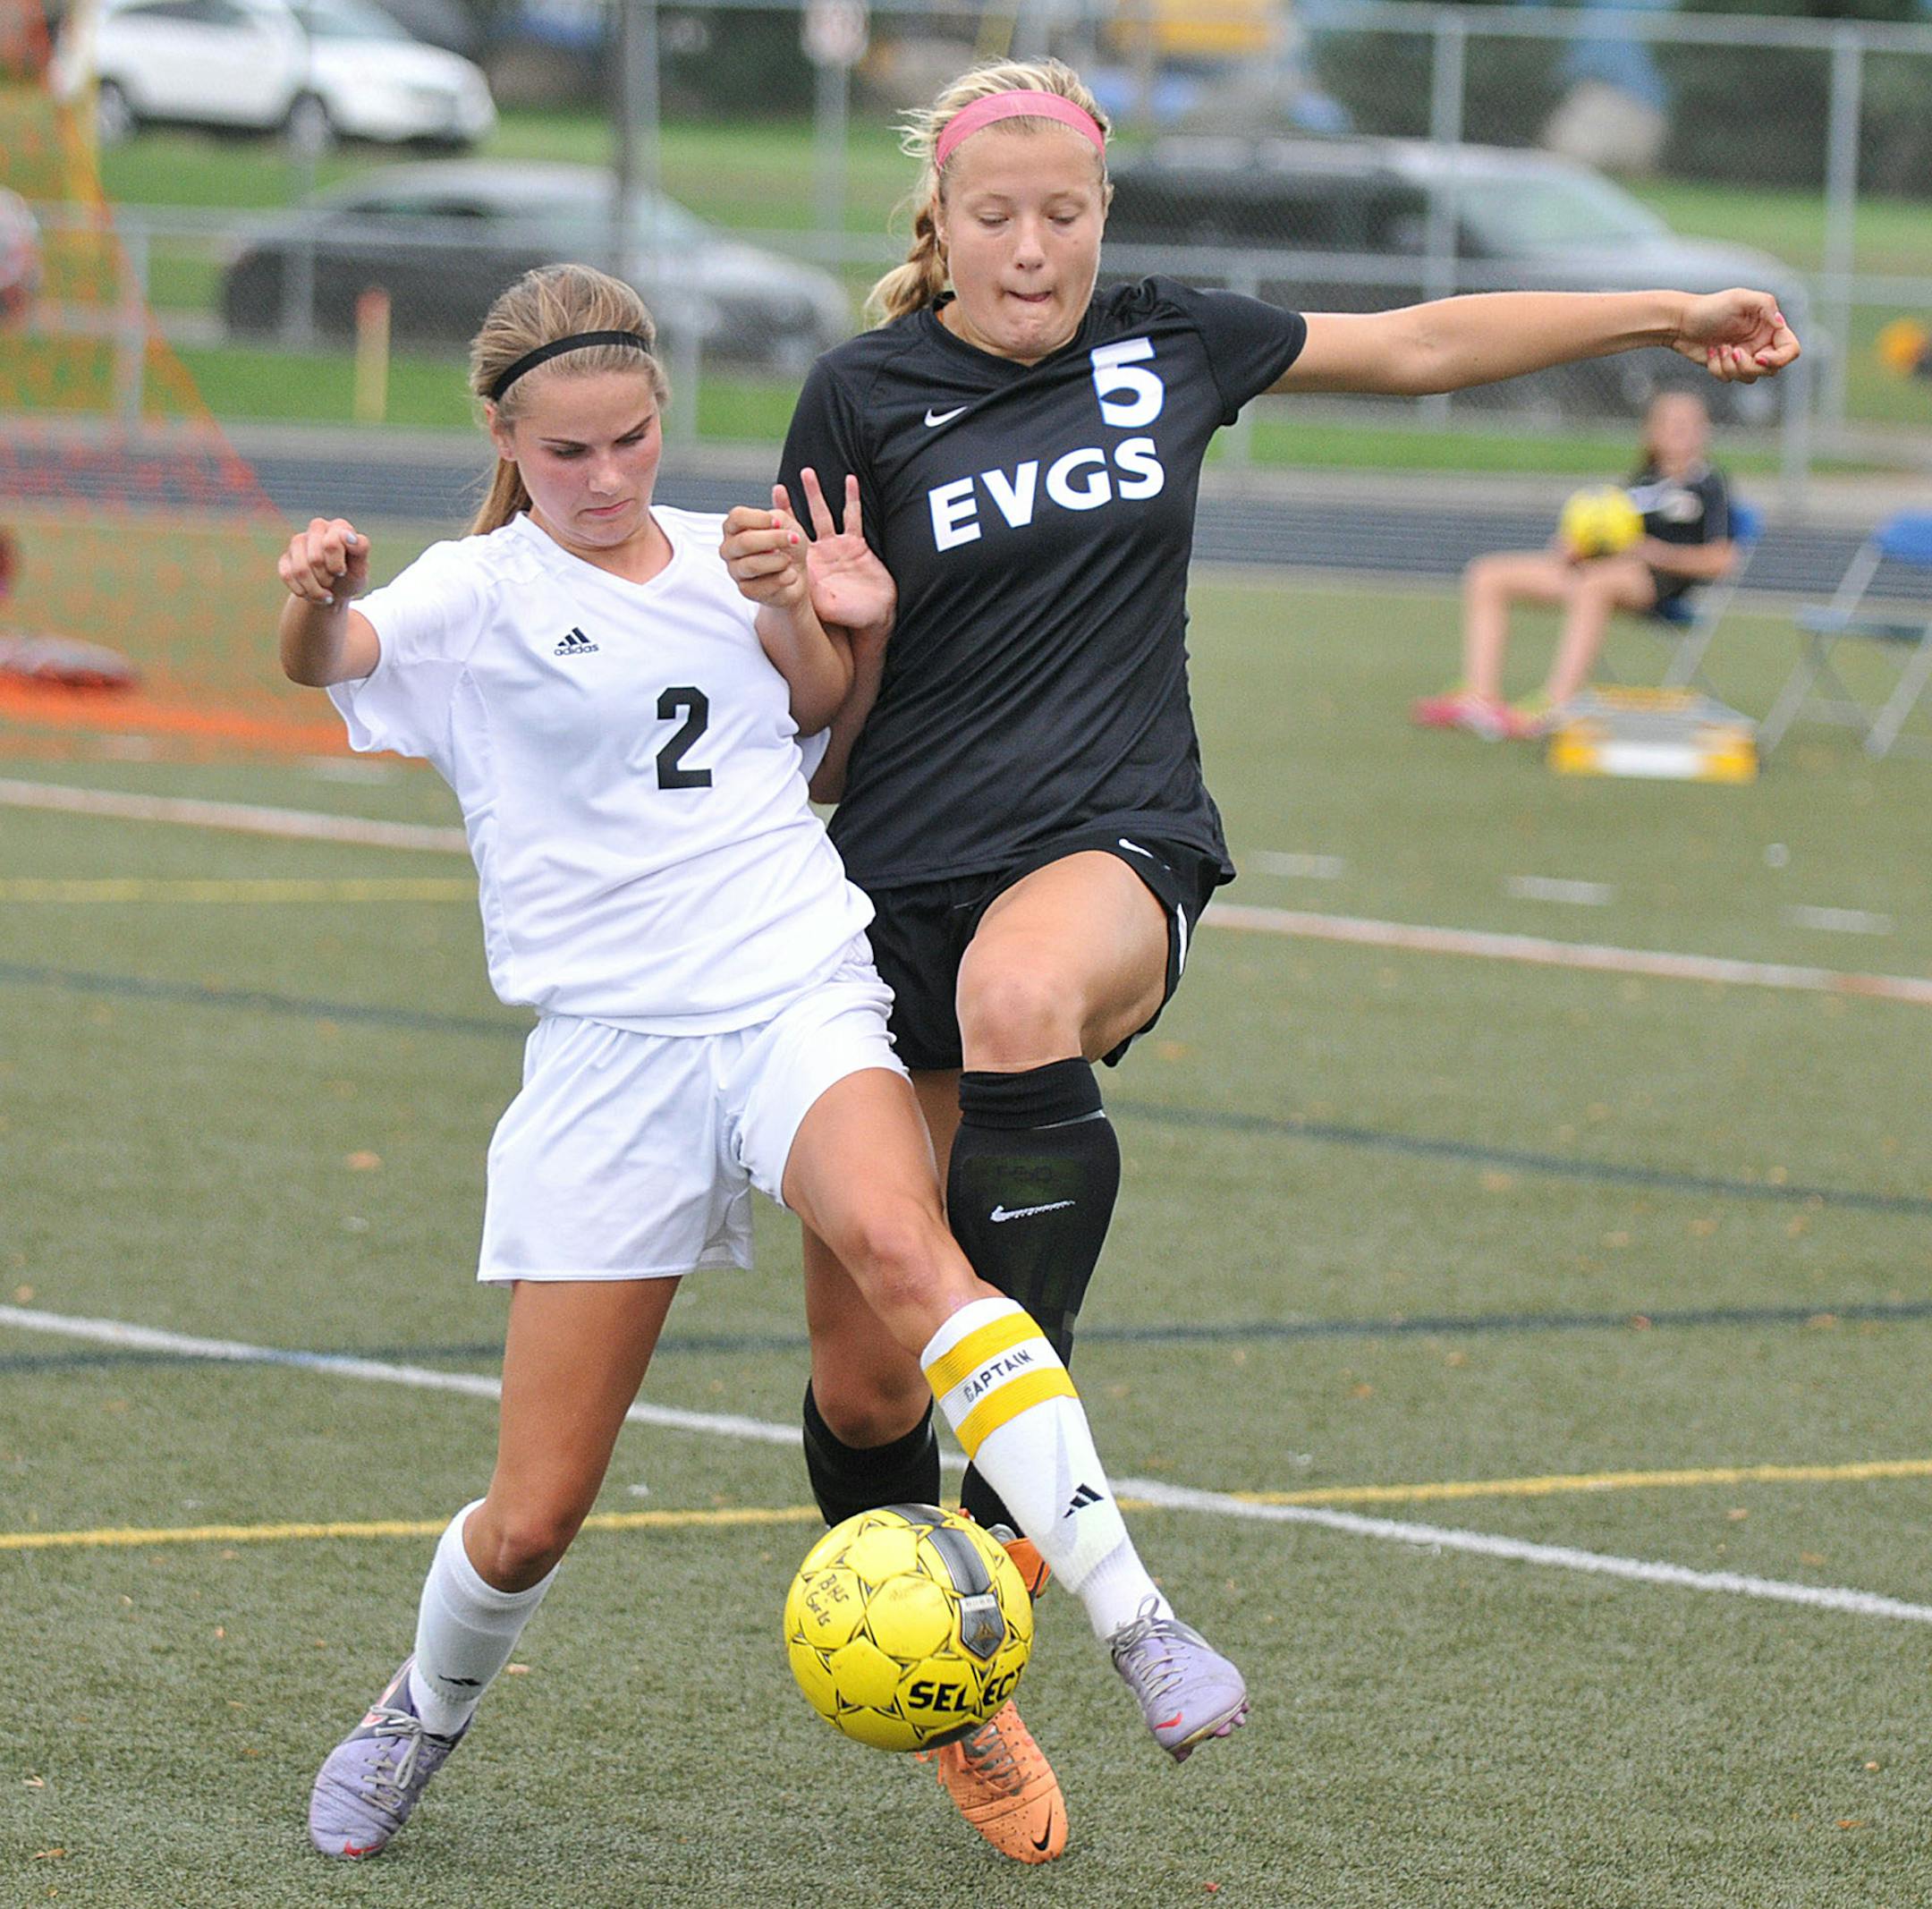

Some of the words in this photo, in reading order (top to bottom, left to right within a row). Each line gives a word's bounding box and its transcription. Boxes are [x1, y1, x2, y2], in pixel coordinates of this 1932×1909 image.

[1090, 336, 1165, 428] 5
[928, 437, 1165, 552] EVGS
[554, 643, 599, 657] adidas
[656, 686, 713, 790] 2
[963, 1349, 1034, 1403] CAPTAIN
